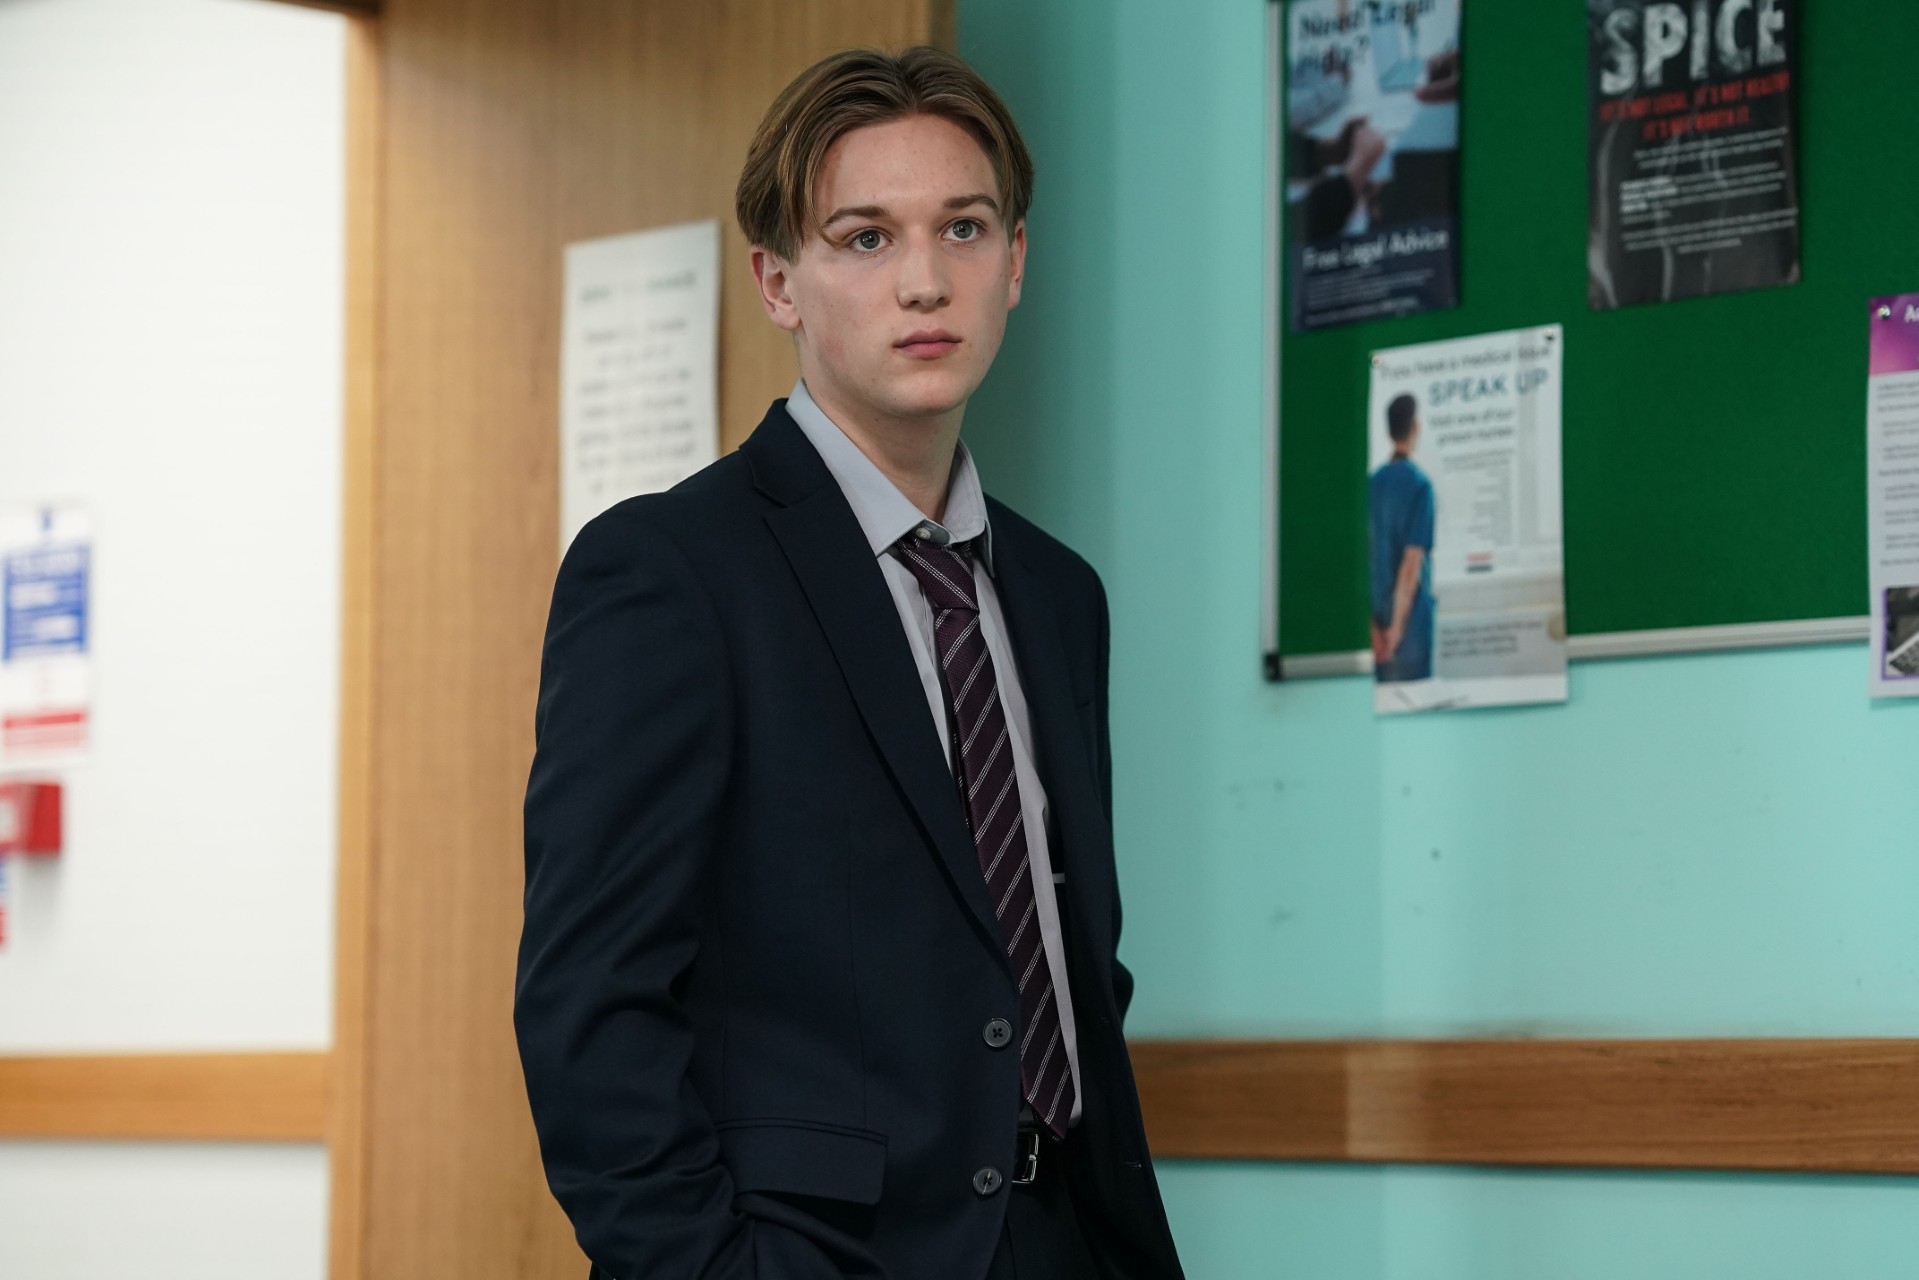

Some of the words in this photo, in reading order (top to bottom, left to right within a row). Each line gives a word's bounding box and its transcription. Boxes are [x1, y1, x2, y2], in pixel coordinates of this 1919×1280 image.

[1301, 10, 1363, 37] Need
[1601, 0, 1786, 95] SPICE
[1341, 234, 1386, 268] Legal
[1388, 227, 1450, 256] Advice
[1429, 375, 1507, 405] SPEAK
[1516, 368, 1548, 394] UP
